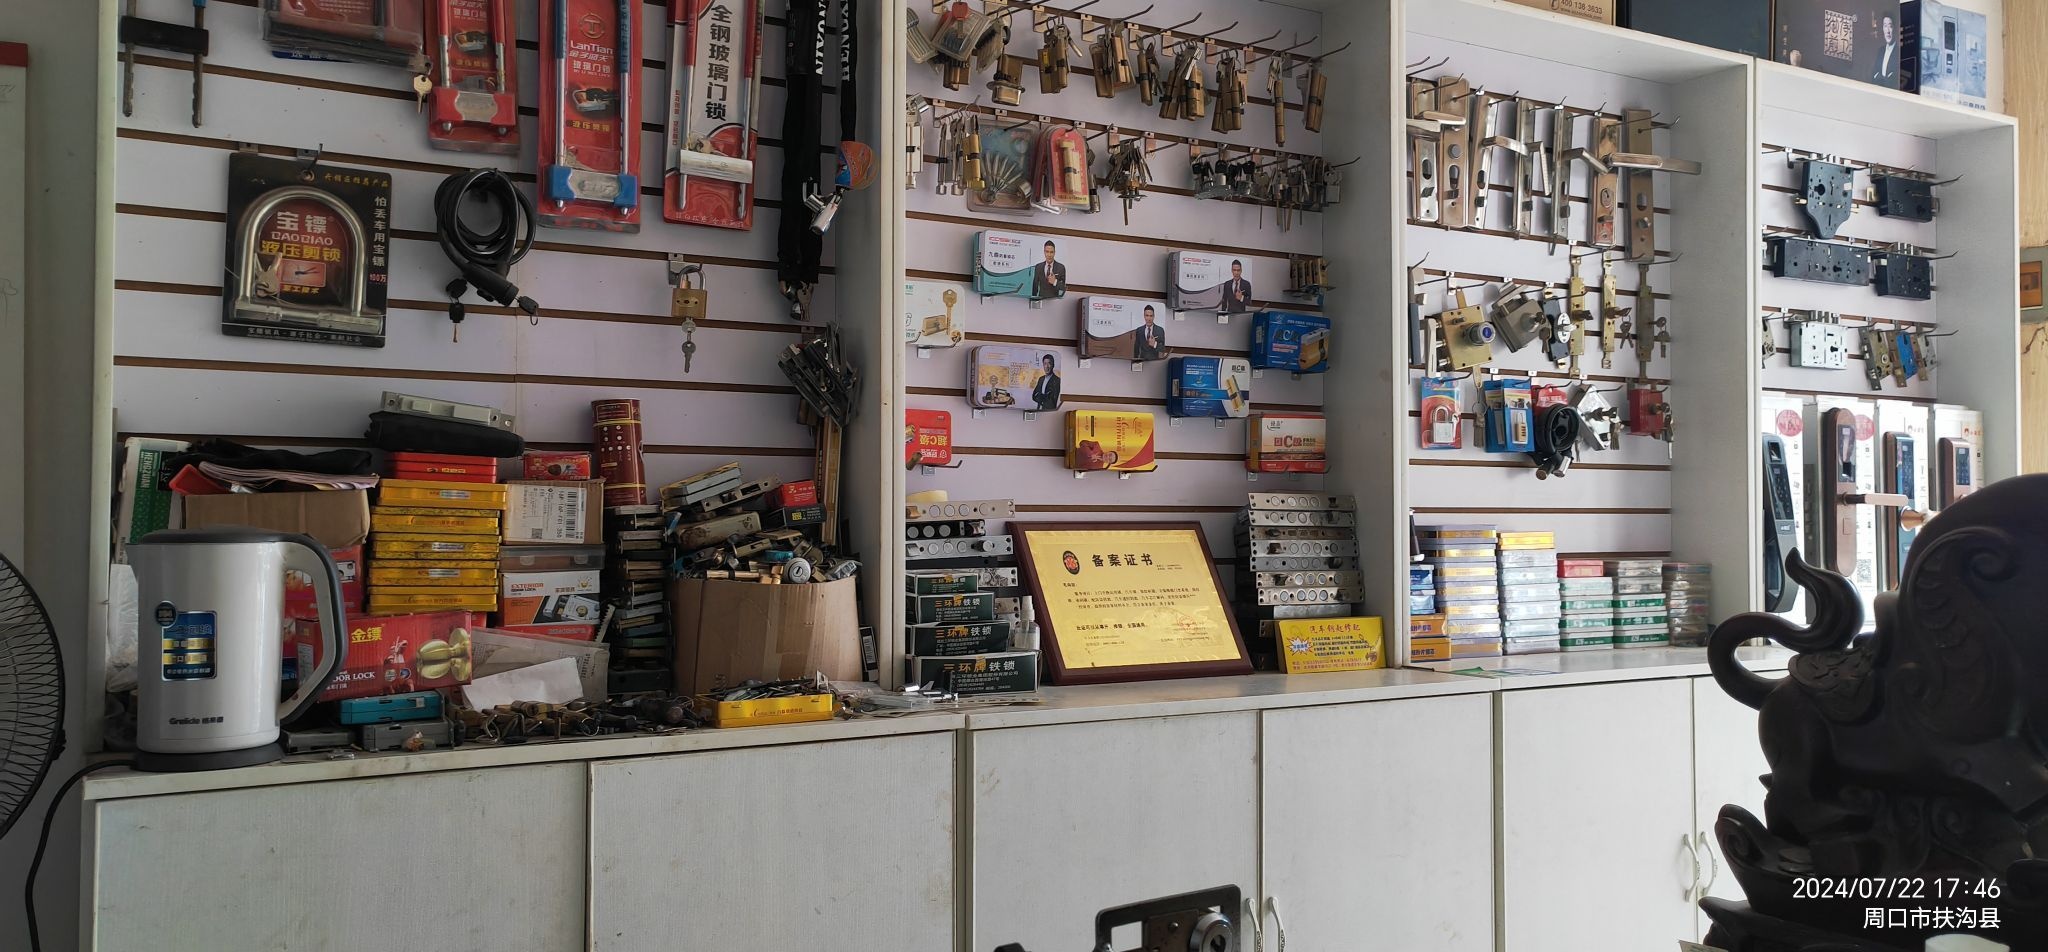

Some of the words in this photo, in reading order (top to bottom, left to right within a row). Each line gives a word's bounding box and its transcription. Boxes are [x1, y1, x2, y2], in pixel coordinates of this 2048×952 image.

[570, 40, 614, 55] LanTian
[705, 4, 732, 121] 全钢玻璃门锁
[277, 212, 327, 234] 宝镖
[919, 434, 948, 447] 超C级
[1092, 553, 1153, 568] 备案证书
[351, 626, 383, 644] 金镖
[936, 625, 992, 639] 三环牌铁锁
[353, 671, 376, 680] LOCK
